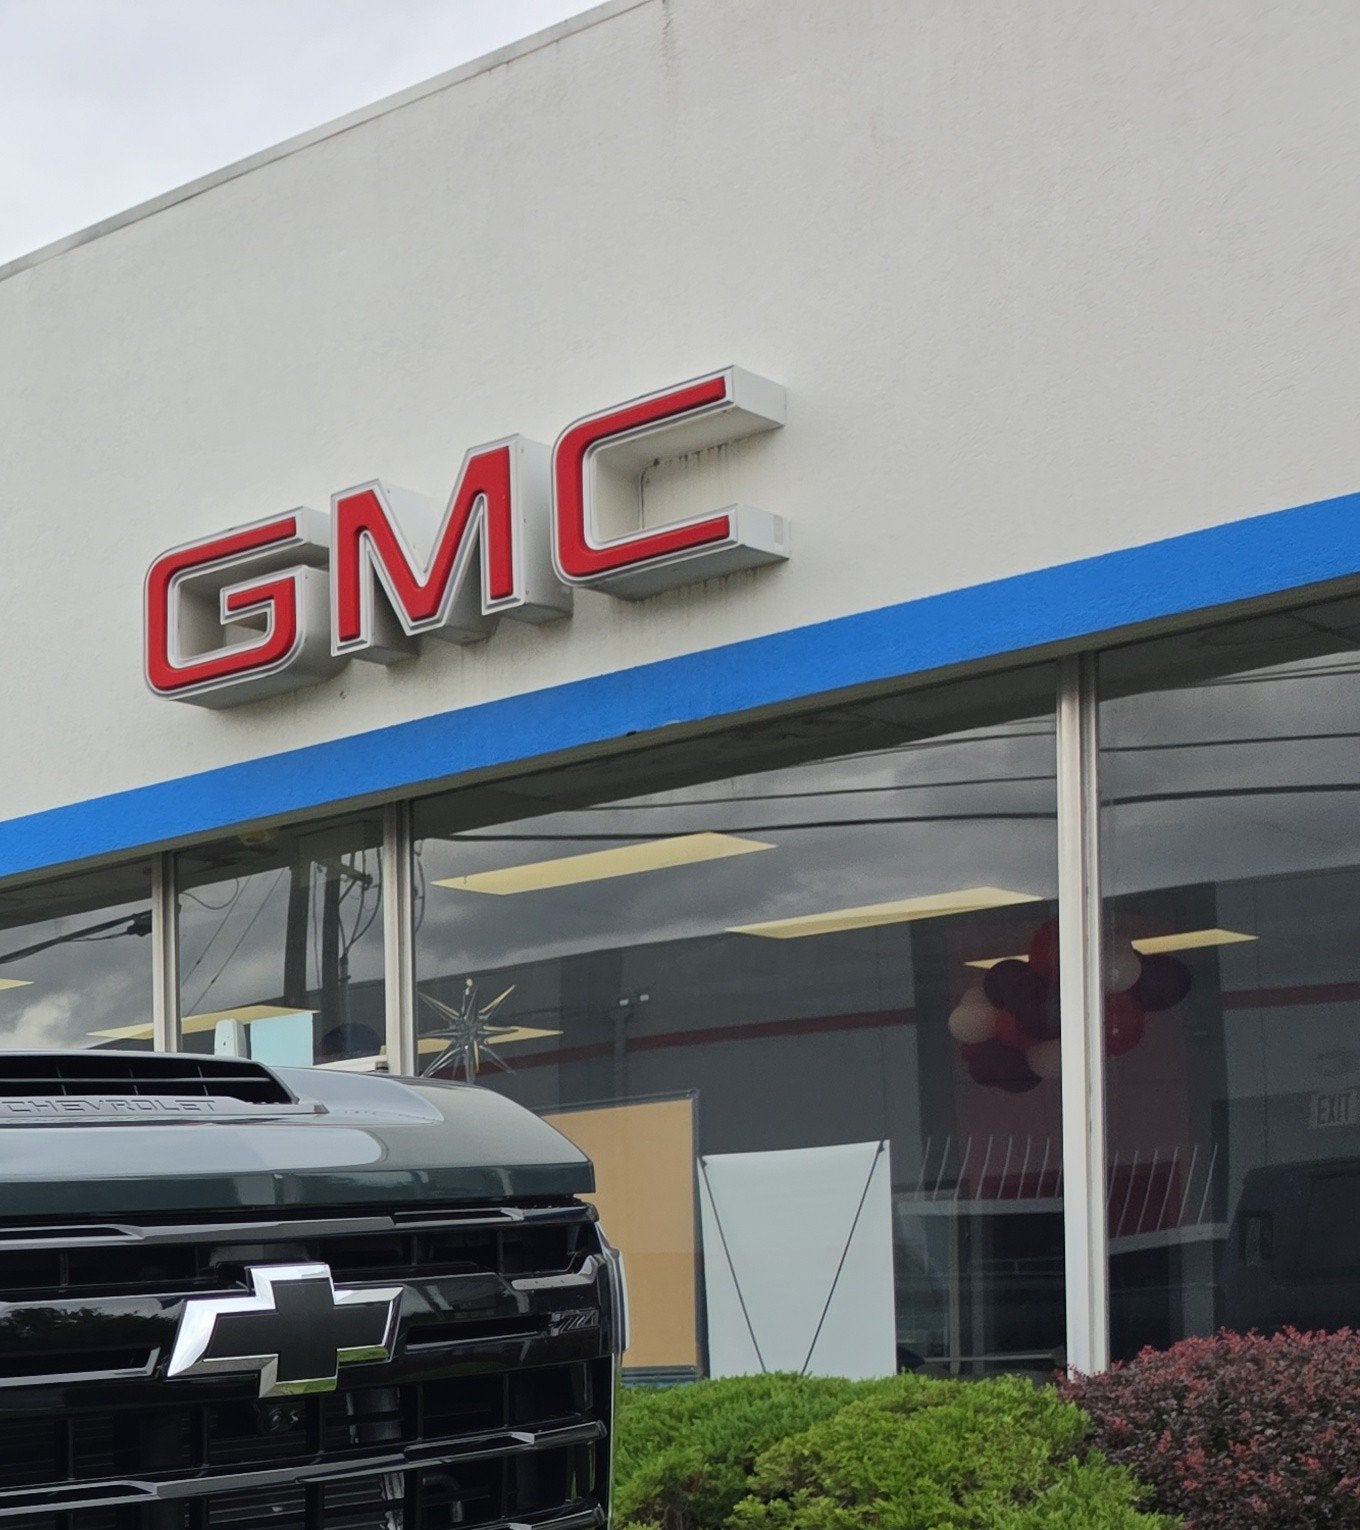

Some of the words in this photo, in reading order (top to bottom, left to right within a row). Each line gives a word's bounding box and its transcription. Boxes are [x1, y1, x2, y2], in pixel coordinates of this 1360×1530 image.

[143, 364, 770, 703] GMC
[1, 1099, 216, 1113] CHEVROLET
[1317, 1093, 1350, 1123] EXIT
